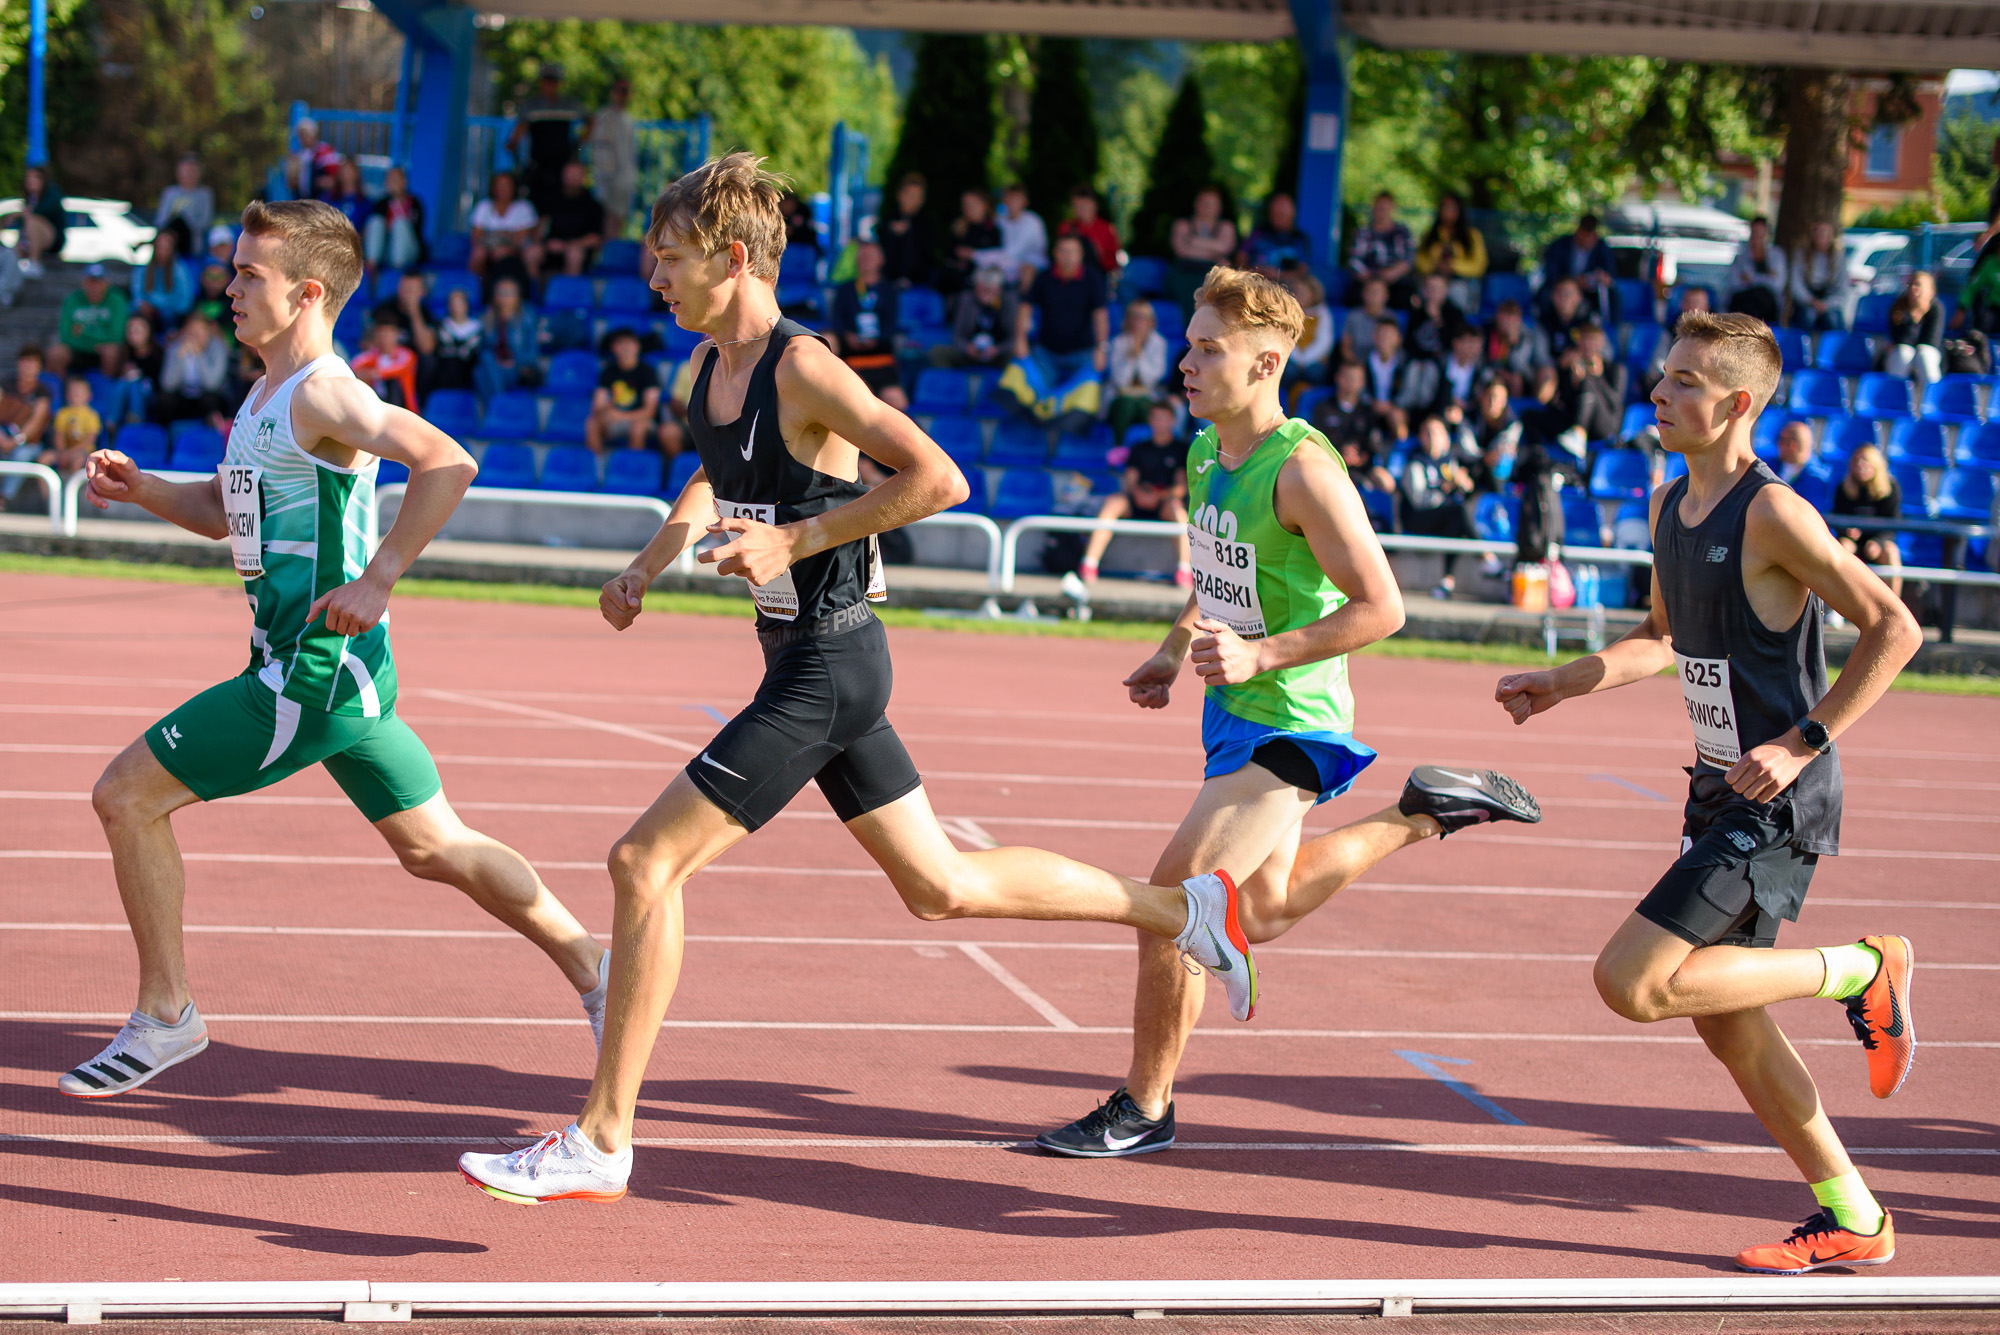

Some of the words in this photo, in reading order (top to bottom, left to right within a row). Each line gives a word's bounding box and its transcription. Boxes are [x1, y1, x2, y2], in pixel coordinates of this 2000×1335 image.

[229, 469, 253, 494] 275
[1214, 540, 1249, 569] 818
[765, 595, 785, 604] Polski
[785, 597, 798, 605] U18
[833, 602, 869, 632] PRO
[1248, 622, 1264, 632] U18
[1684, 661, 1721, 688] 625
[1728, 750, 1740, 760] U18
